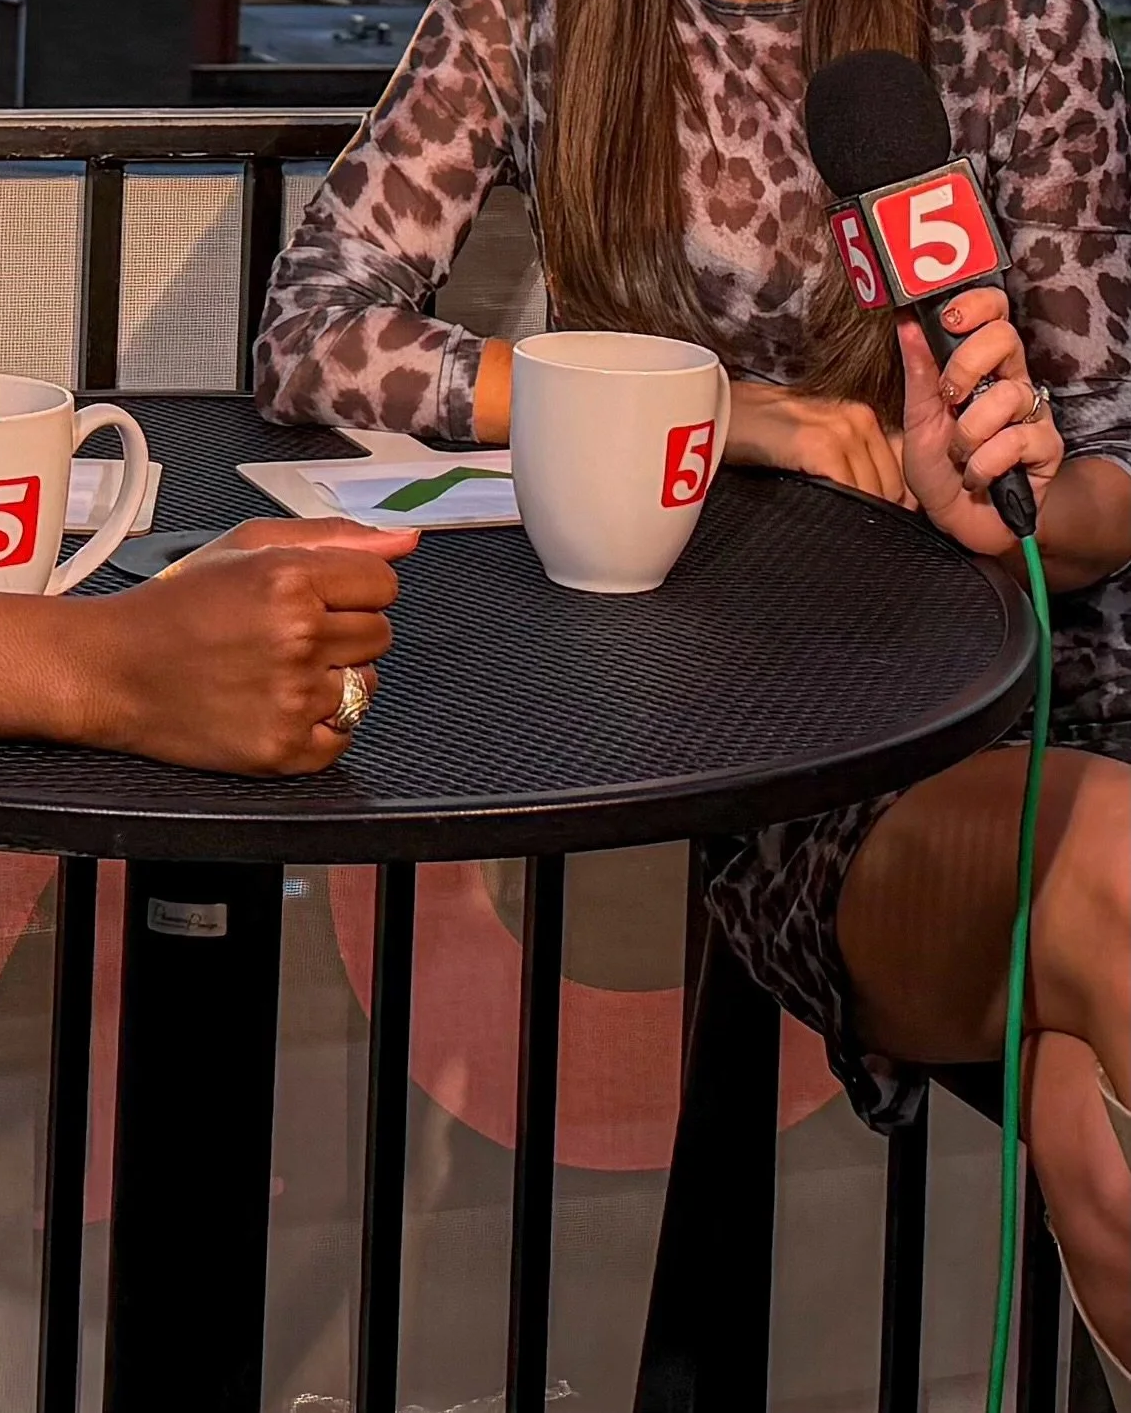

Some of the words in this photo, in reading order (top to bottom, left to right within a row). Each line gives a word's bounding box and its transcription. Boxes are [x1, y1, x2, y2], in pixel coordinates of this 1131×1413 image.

[841, 216, 877, 304] 5
[909, 183, 970, 283] 5
[671, 425, 711, 501] 5
